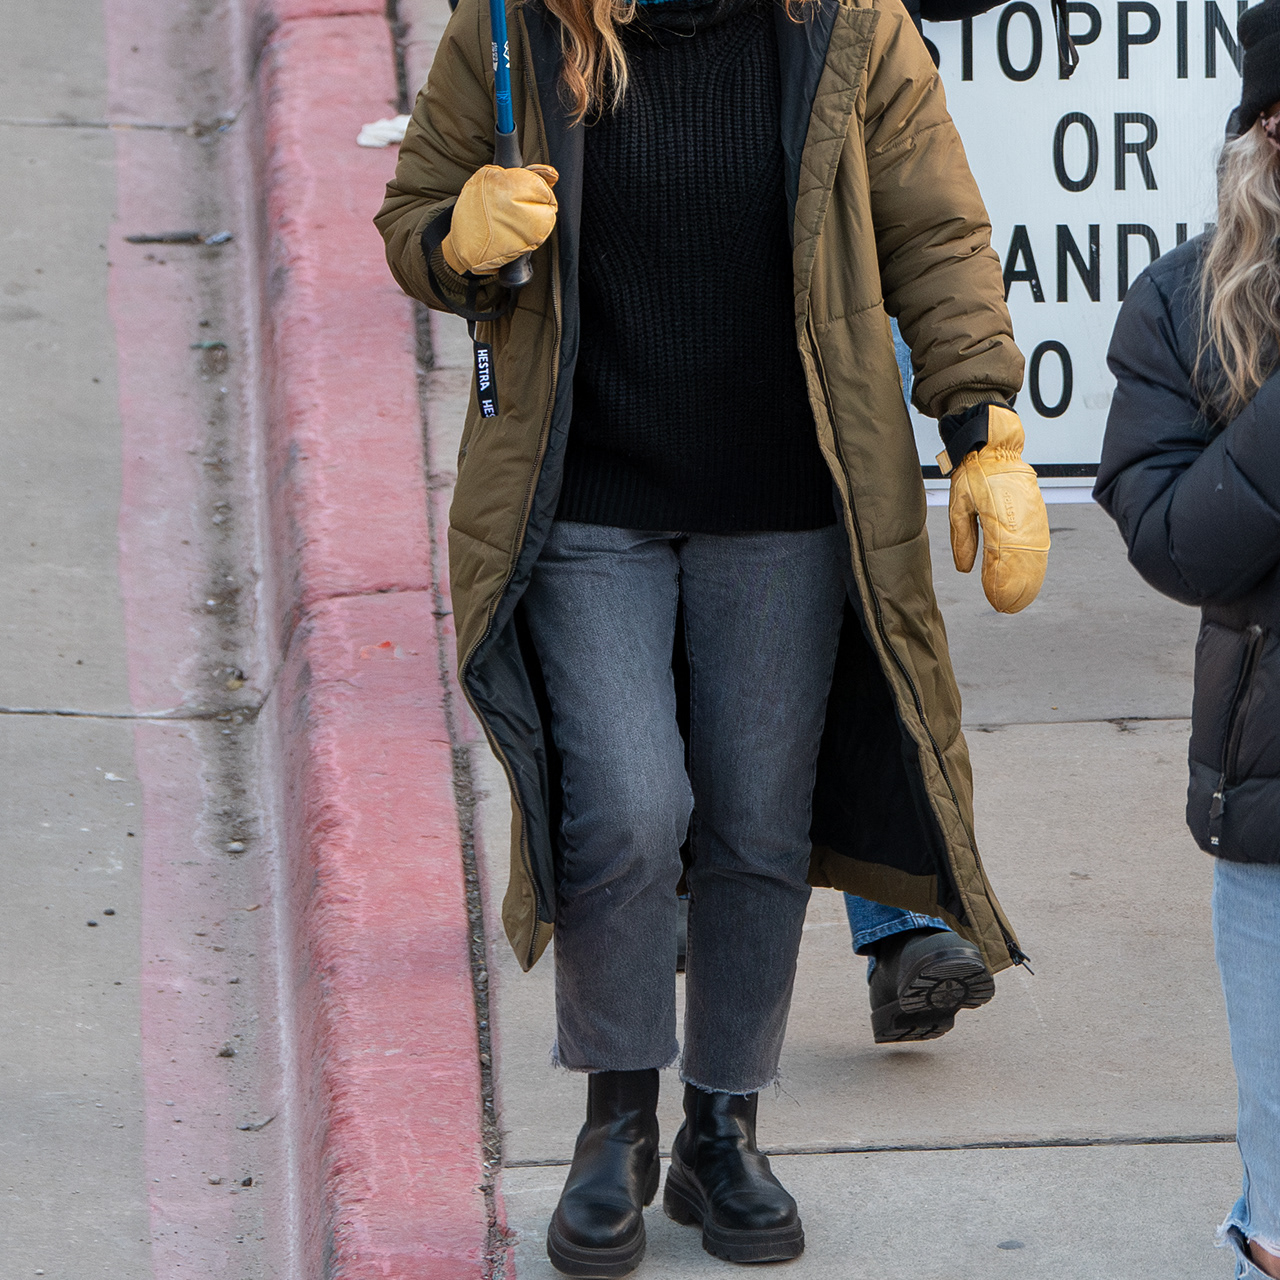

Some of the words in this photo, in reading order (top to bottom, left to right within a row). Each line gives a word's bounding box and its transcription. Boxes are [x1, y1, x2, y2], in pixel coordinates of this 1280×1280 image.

[928, 0, 1246, 82] TOPPIN
[1053, 111, 1158, 192] OR
[477, 349, 491, 391] HESTRA
